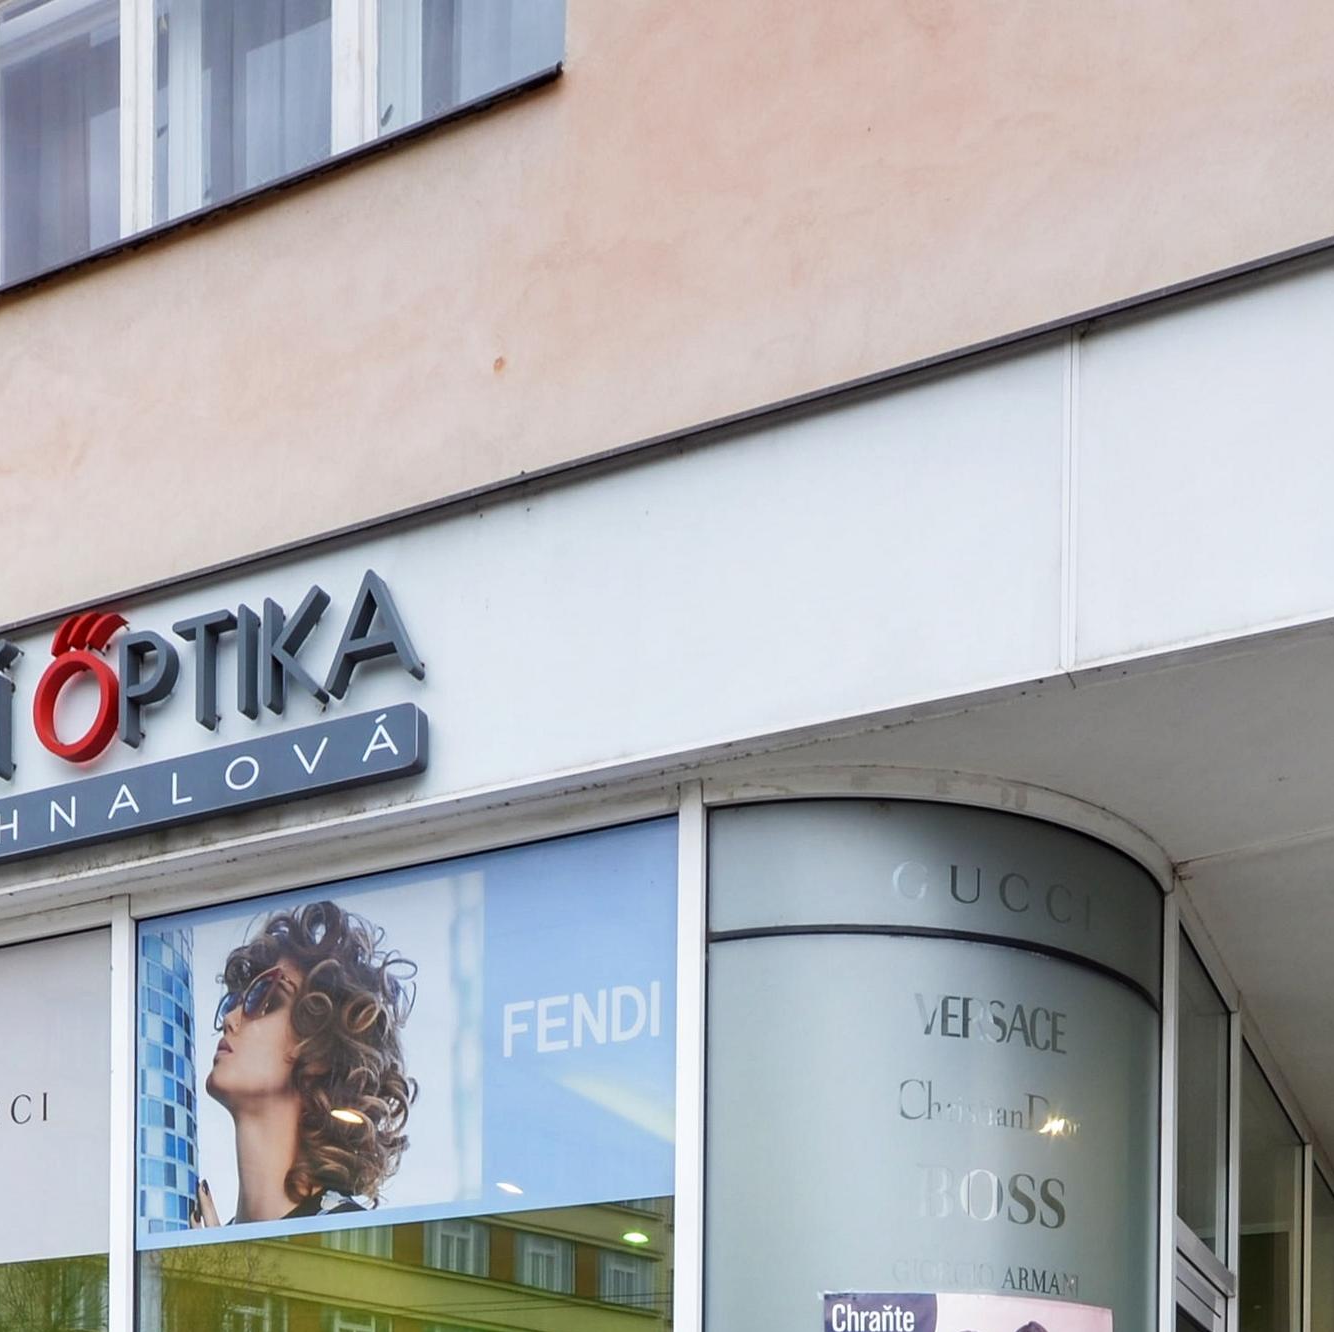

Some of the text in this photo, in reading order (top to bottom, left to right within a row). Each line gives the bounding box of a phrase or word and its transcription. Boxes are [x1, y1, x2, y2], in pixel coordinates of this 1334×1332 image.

[33, 569, 426, 764] OPTIKA
[892, 860, 1092, 930] GUCCI
[502, 980, 661, 1058] FENDI
[914, 993, 1067, 1055] VERSACE
[917, 1161, 1067, 1229] BOSS
[1001, 1265, 1079, 1297] ARMANI
[831, 1303, 915, 1332] Chraňte
